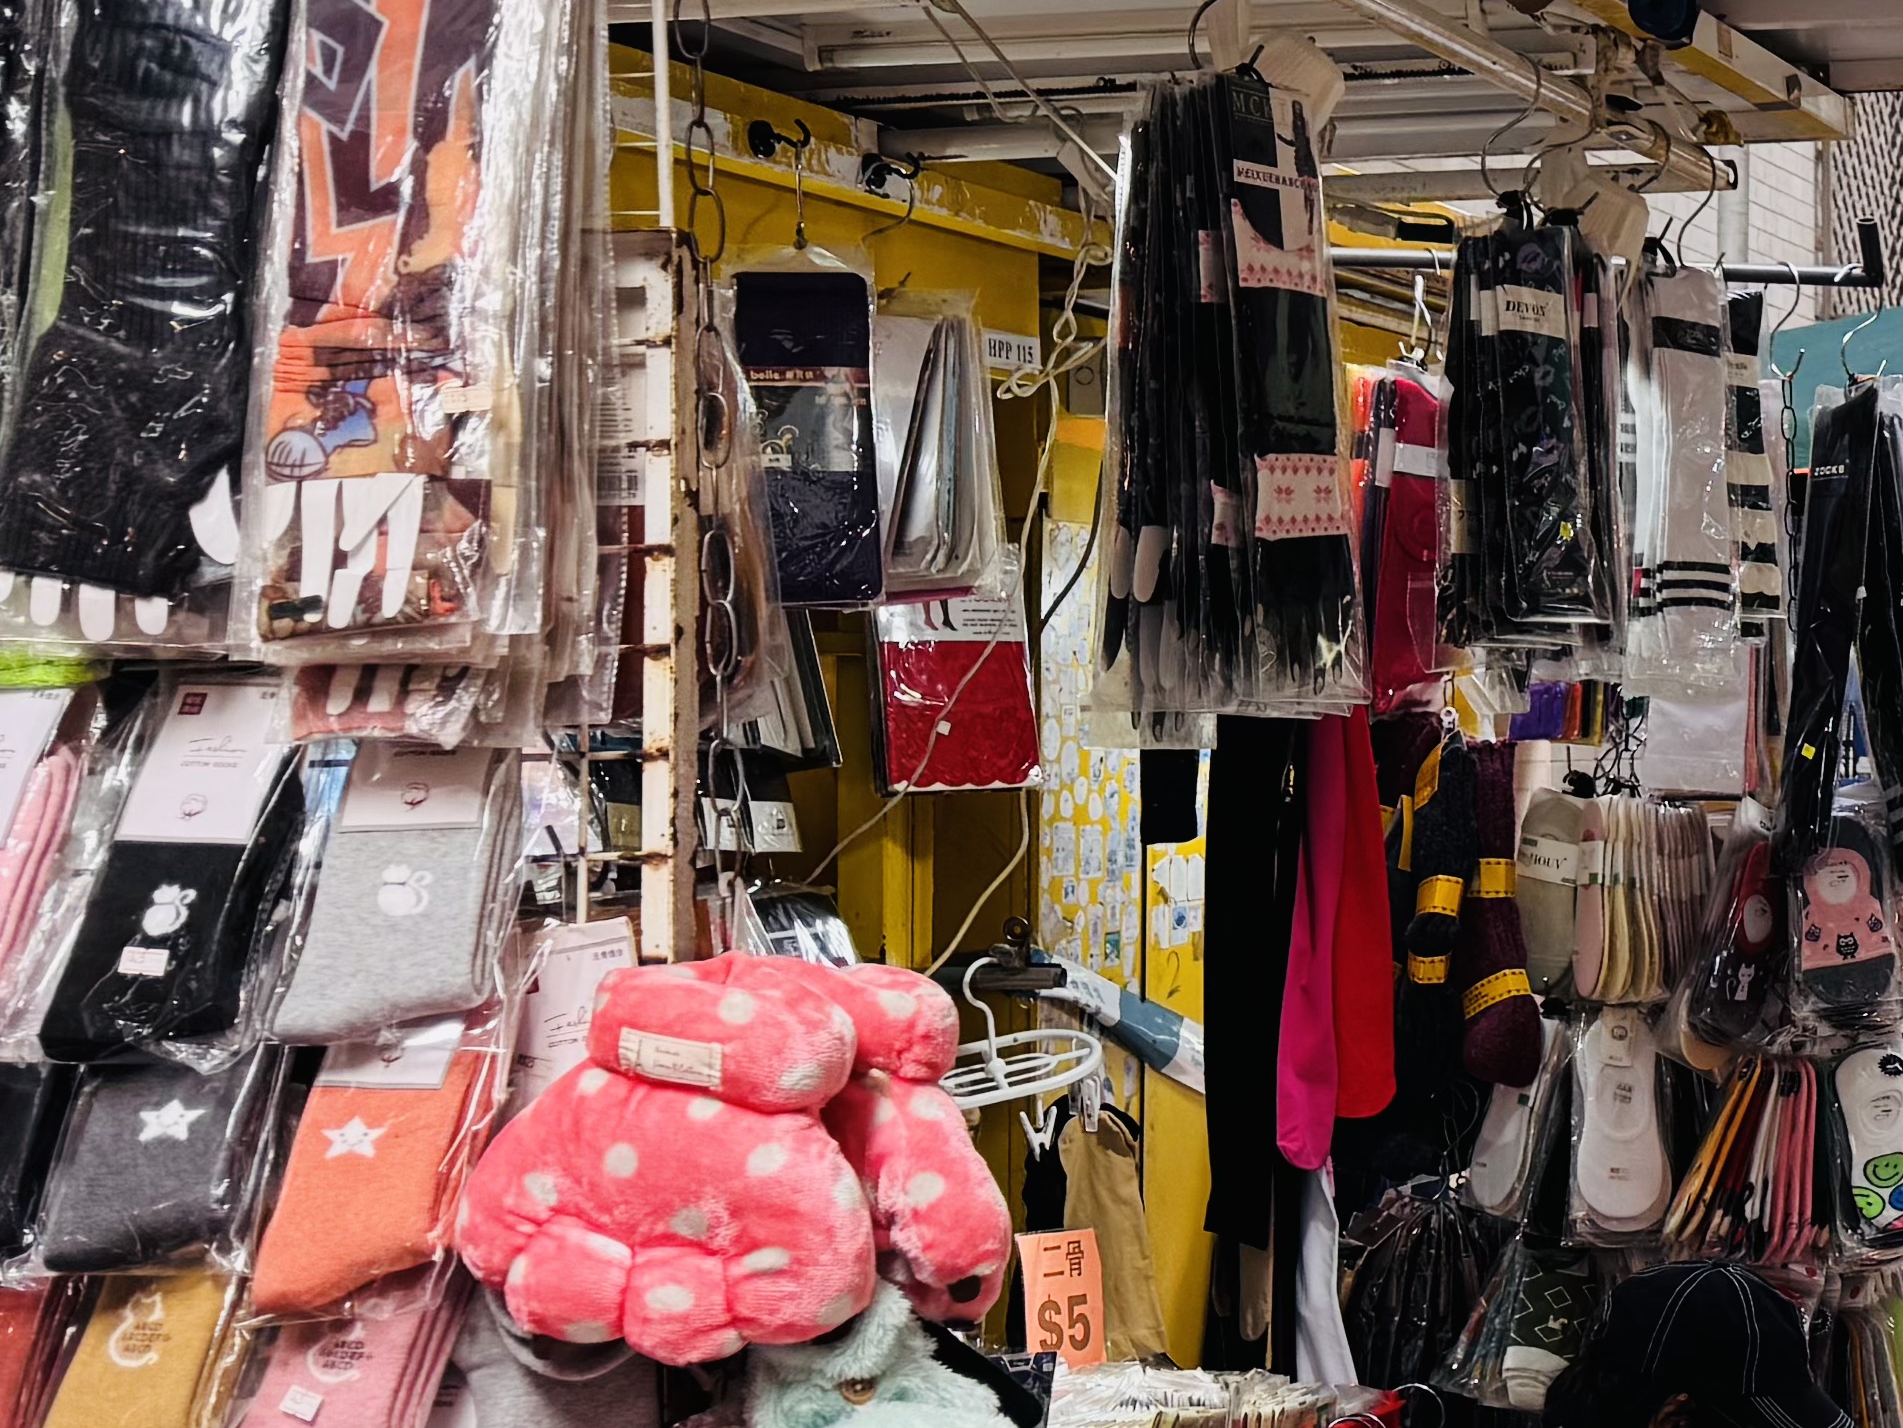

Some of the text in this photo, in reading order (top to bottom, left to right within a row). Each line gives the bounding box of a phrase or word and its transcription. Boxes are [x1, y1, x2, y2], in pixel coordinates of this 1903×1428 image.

[988, 337, 1034, 364] HPP 115
[1043, 1239, 1084, 1278] 二骨
[1037, 1293, 1092, 1352] $5
